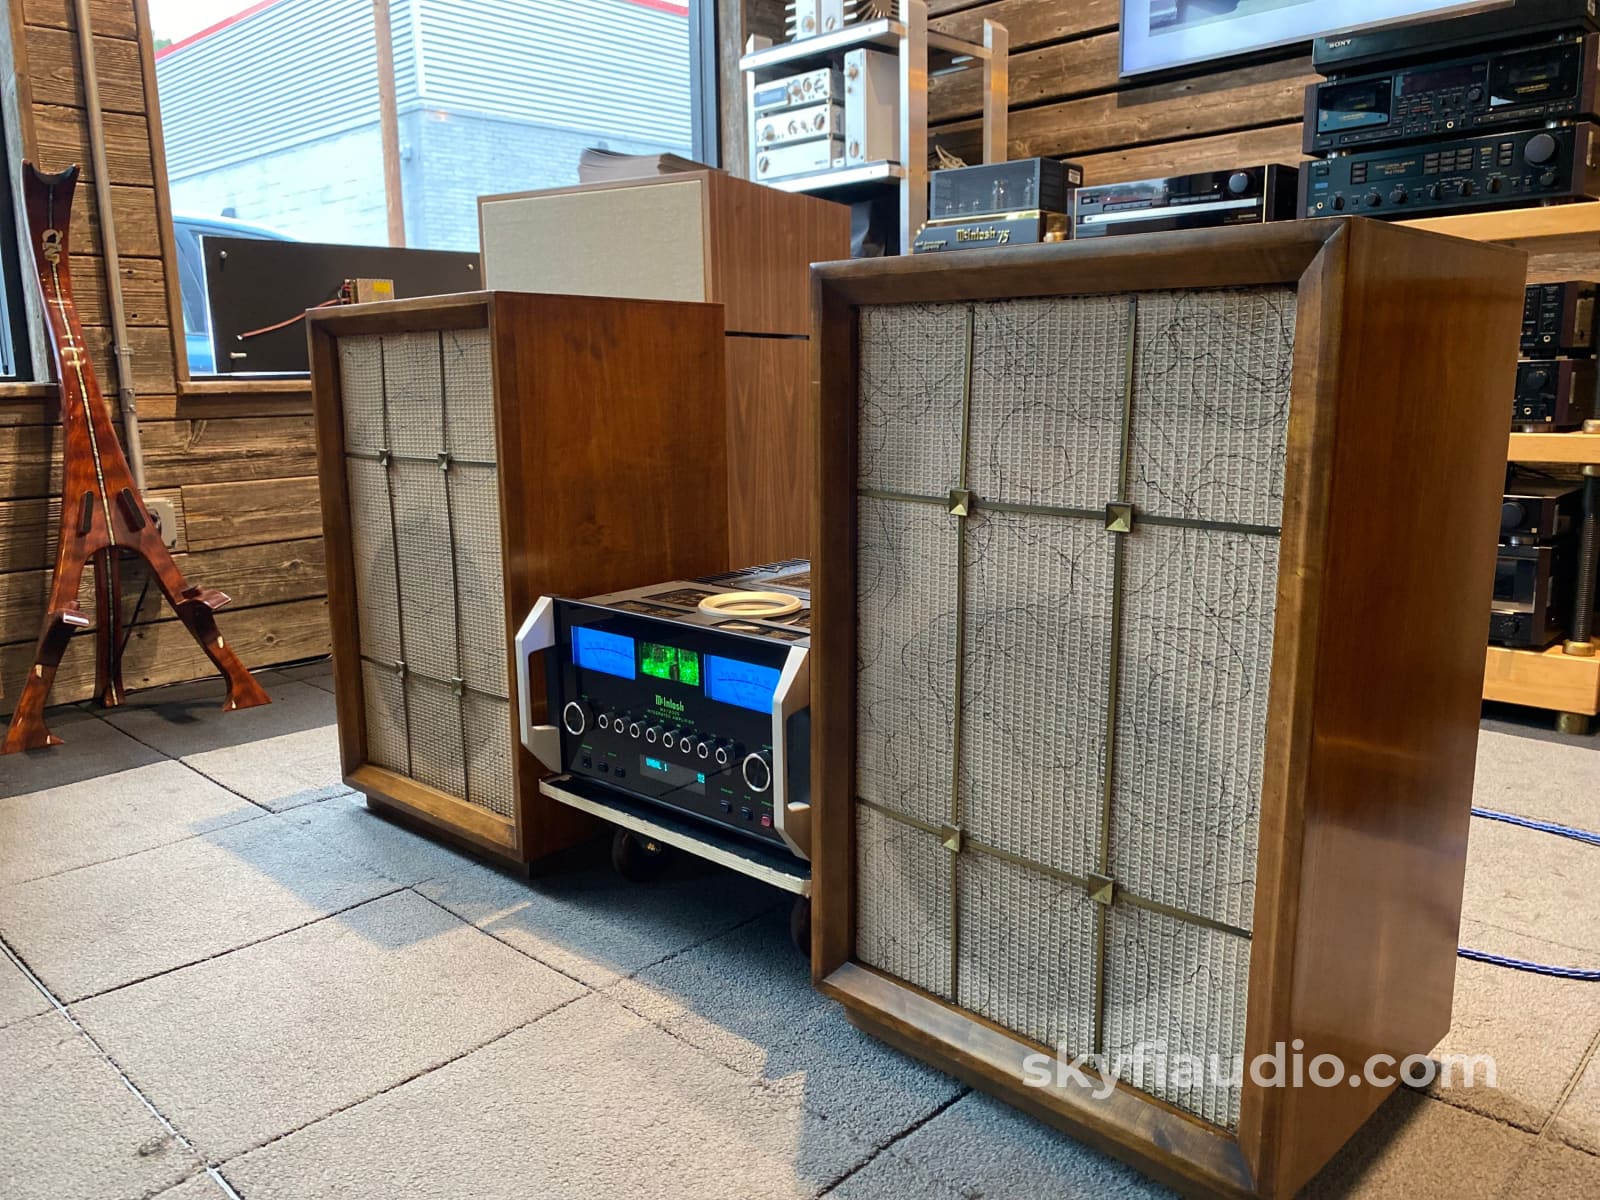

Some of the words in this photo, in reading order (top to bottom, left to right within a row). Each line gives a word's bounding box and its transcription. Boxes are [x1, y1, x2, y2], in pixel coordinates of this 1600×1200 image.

[1328, 39, 1352, 49] SONY
[997, 229, 1010, 244] 75
[655, 694, 685, 712] McIntosh
